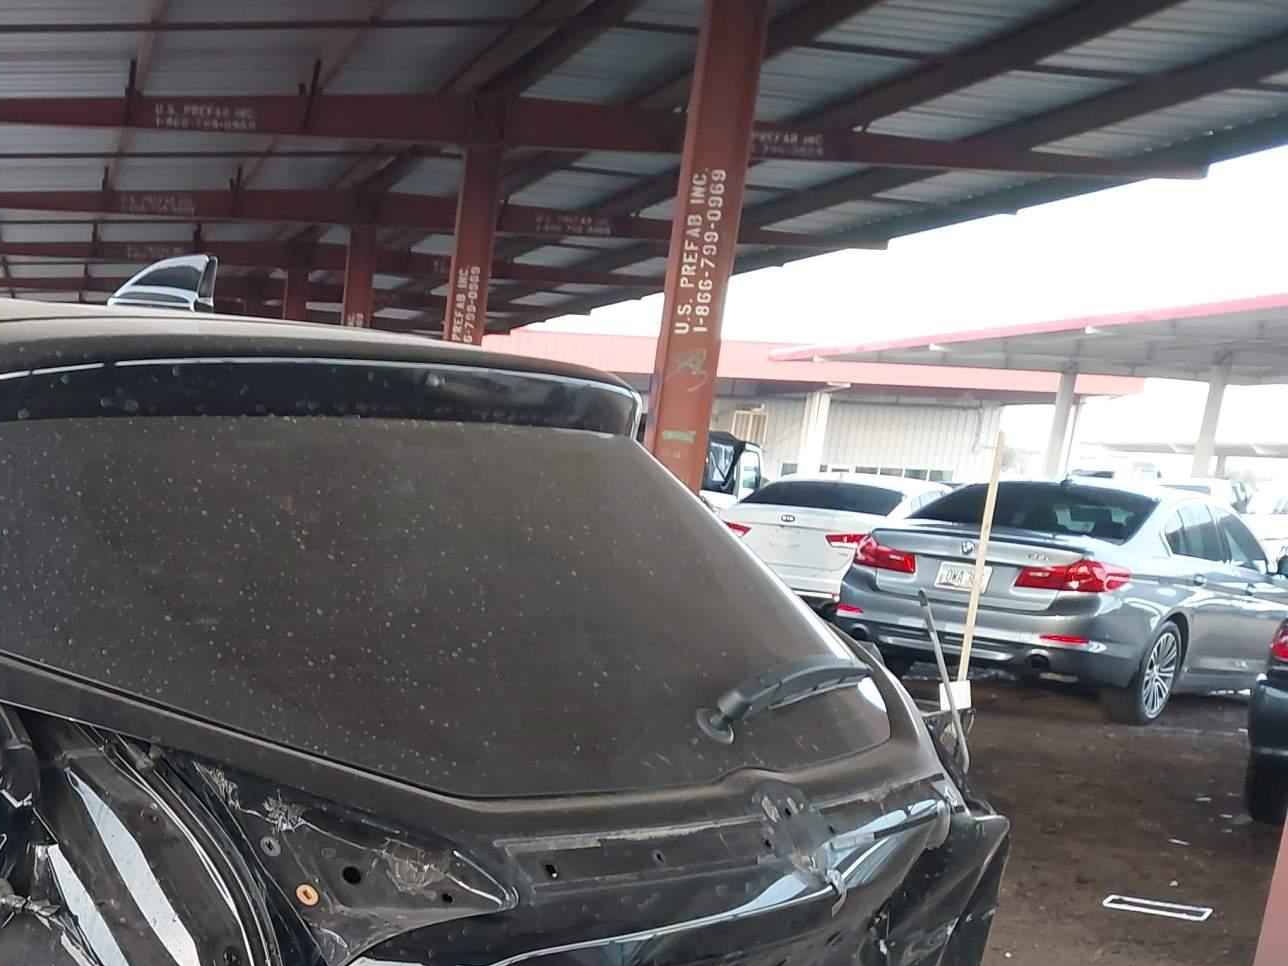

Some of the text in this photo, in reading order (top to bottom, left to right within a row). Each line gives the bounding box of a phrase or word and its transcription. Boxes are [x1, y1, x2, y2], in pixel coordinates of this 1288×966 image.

[674, 167, 710, 335] U.S. PREFAB INC.
[693, 168, 727, 333] 1-866-799-0969
